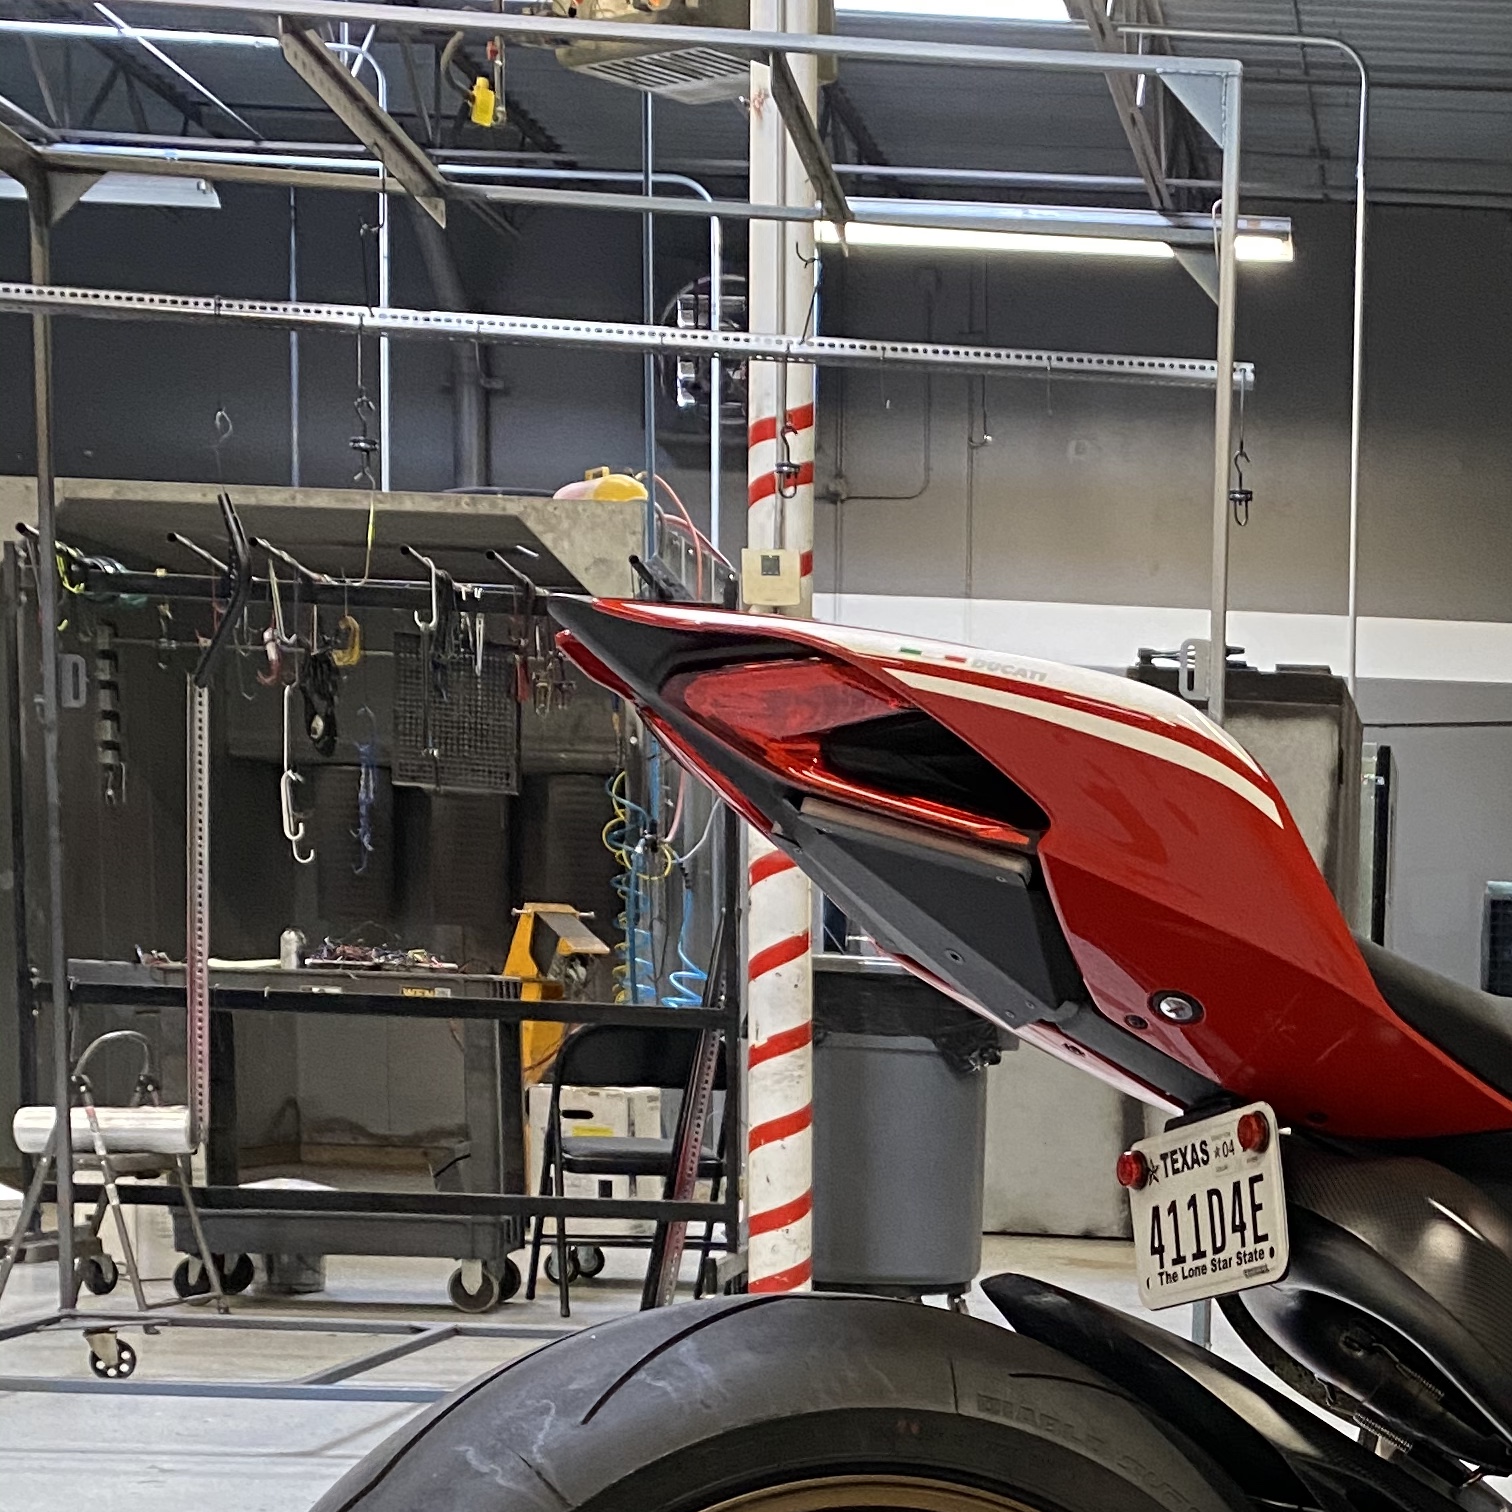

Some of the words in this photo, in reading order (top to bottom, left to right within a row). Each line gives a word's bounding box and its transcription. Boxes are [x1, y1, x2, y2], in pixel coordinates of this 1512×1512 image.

[971, 659, 1047, 682] DUCATI
[1160, 1140, 1210, 1178] TEXAS
[1150, 1173, 1269, 1269] 411D4E
[1158, 1270, 1178, 1287] The
[1182, 1264, 1207, 1280] Lone
[1211, 1256, 1232, 1273] Star
[1236, 1248, 1265, 1267] State
